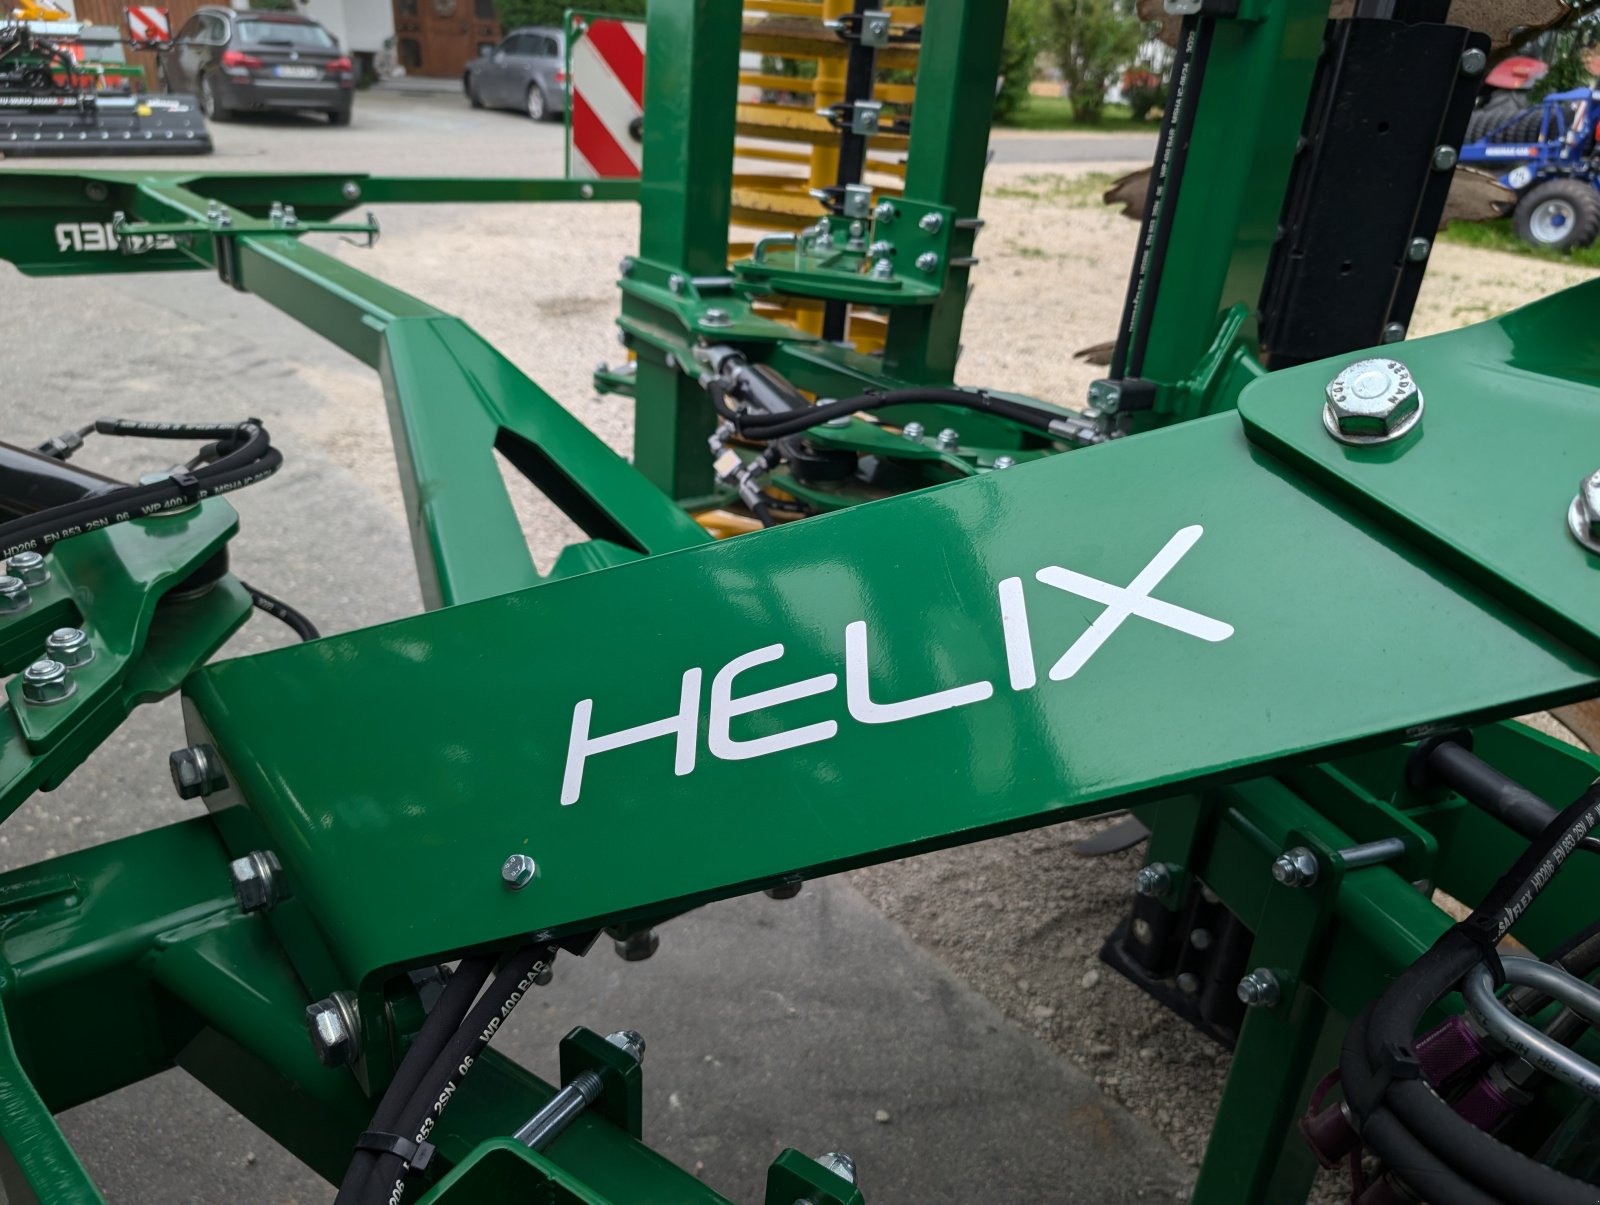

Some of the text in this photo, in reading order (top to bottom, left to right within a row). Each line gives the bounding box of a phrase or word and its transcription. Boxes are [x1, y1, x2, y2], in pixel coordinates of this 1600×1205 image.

[44, 529, 61, 545] EN
[63, 525, 82, 539] 853
[141, 504, 161, 516] WP
[164, 497, 183, 509] 400
[559, 523, 1236, 807] HELIX
[1531, 859, 1555, 892] HD206
[1552, 845, 1568, 866] EN
[1562, 833, 1576, 854] 853
[1572, 820, 1587, 842] 2SN
[1585, 812, 1595, 828] 06
[434, 1081, 457, 1117] 2SN
[458, 1055, 474, 1077] 06
[479, 1016, 501, 1043] WP
[501, 992, 522, 1018] 400
[518, 959, 547, 992] BAR
